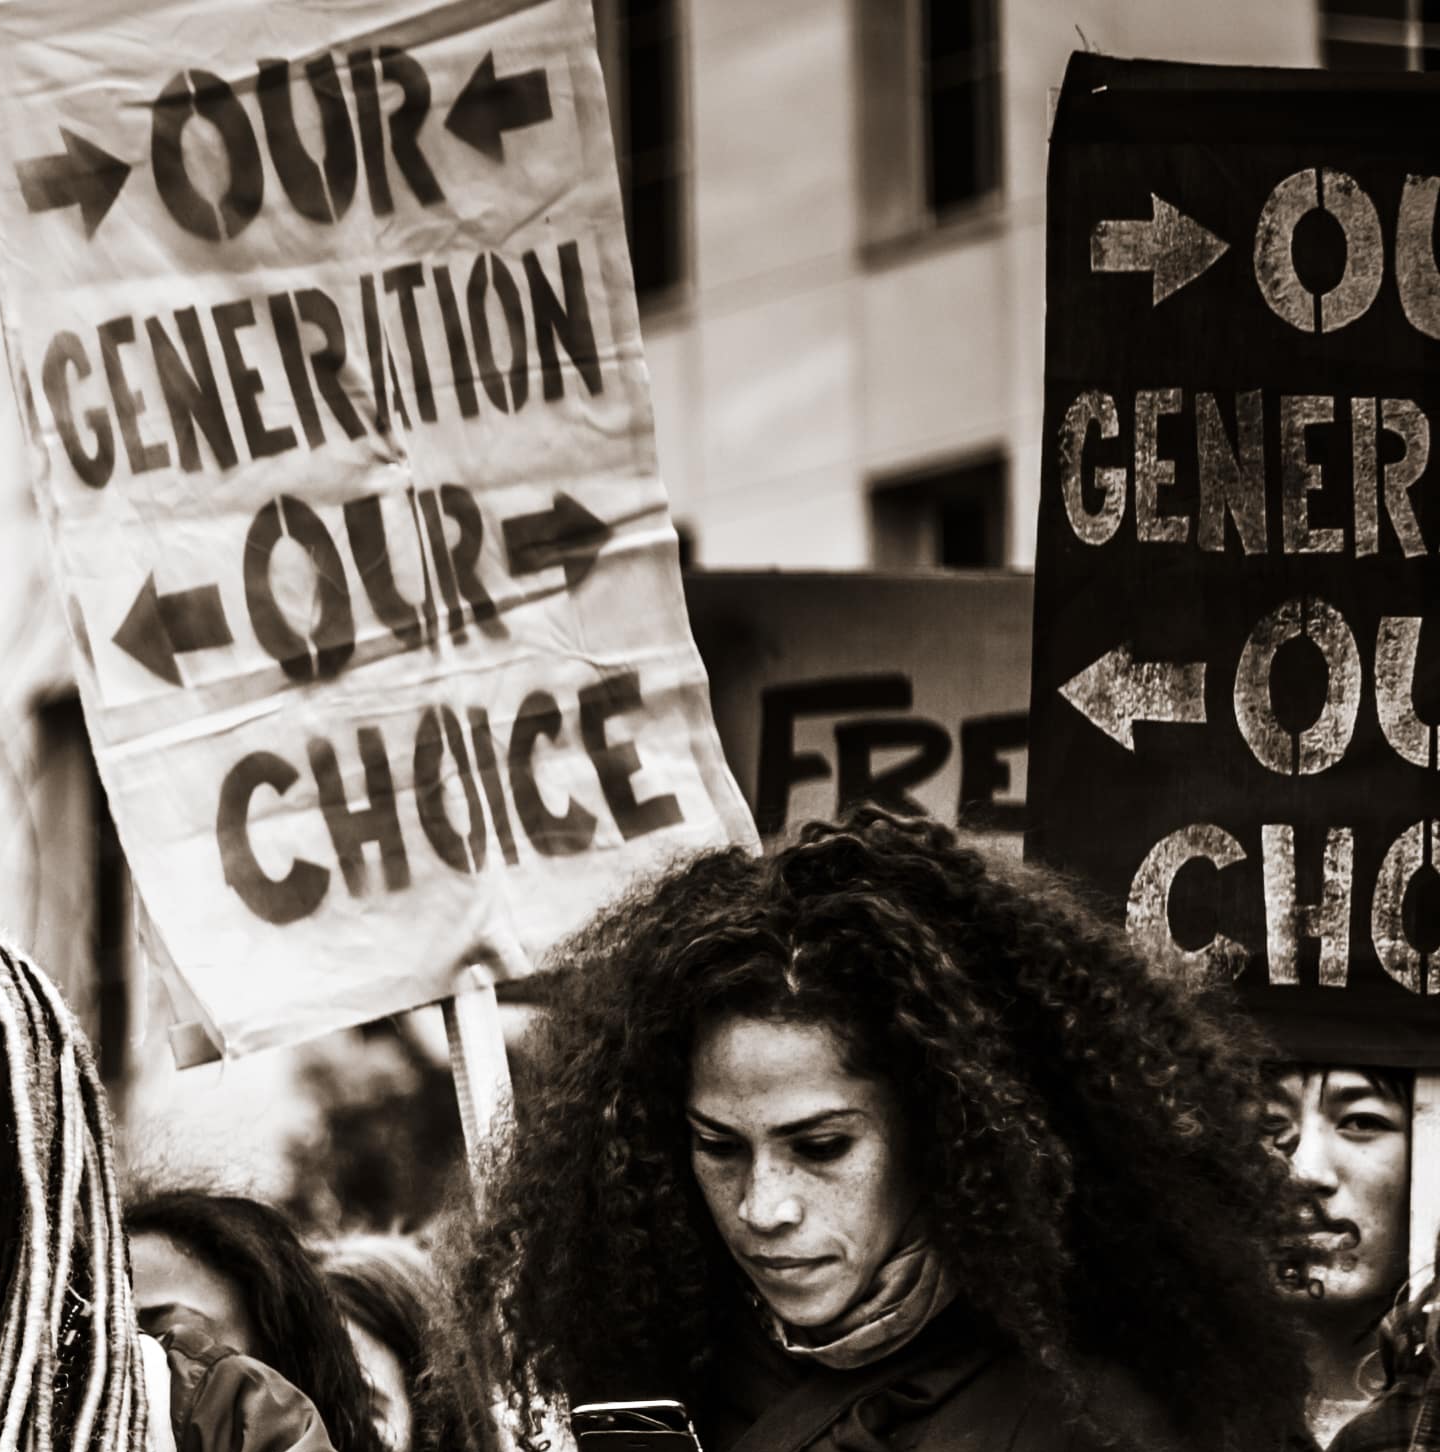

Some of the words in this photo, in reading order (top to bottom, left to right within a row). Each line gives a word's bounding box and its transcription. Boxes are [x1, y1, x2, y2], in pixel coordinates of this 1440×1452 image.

[150, 44, 448, 243] OUR
[40, 240, 606, 489] GENERATION
[1058, 387, 1440, 559] GENER
[242, 483, 511, 683] OUR
[215, 672, 687, 925] CHOICE
